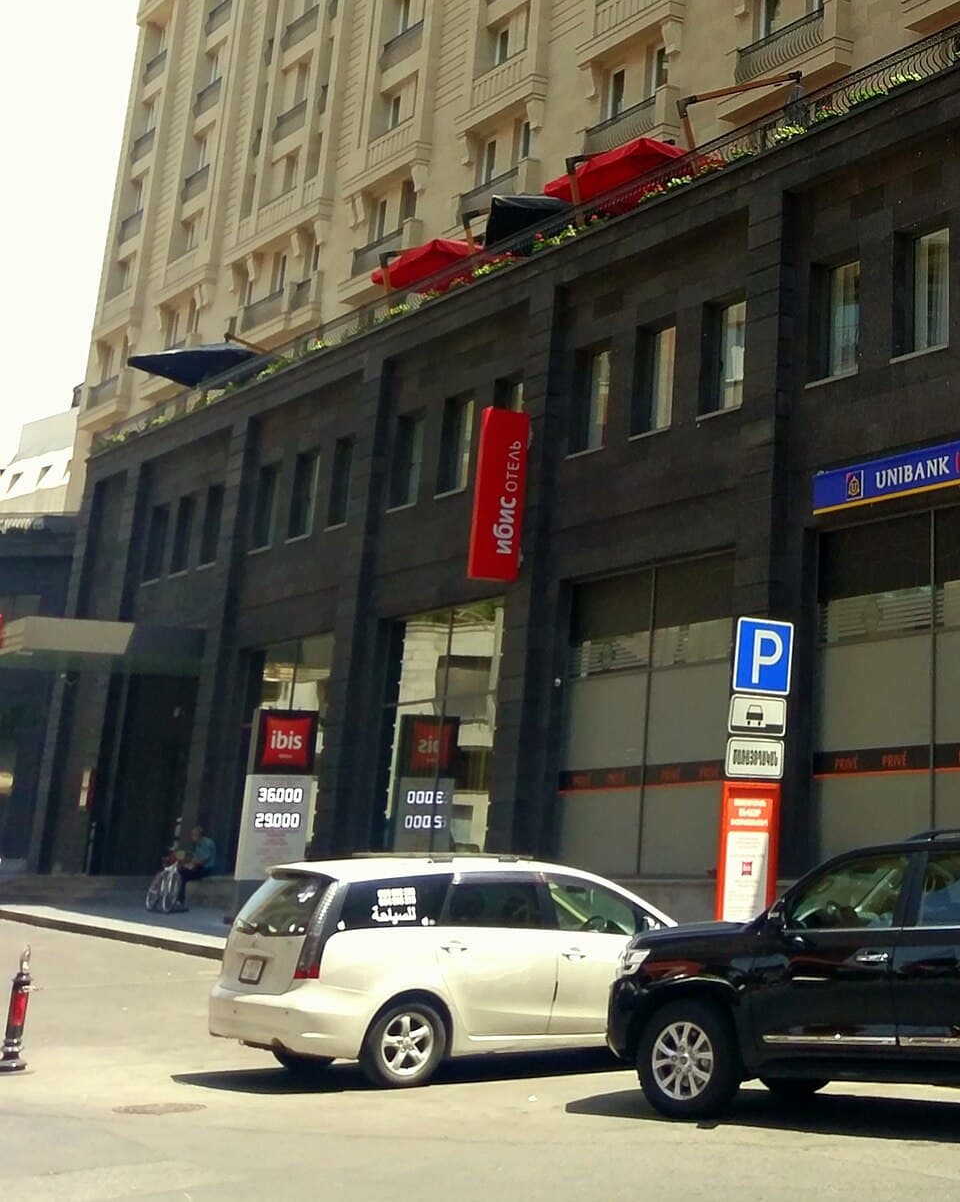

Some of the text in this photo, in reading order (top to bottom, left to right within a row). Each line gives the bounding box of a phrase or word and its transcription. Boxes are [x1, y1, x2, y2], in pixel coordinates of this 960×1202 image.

[505, 440, 522, 493] ОТЕЛЬ
[875, 455, 950, 489] UNIBANK
[751, 629, 783, 684] P
[270, 729, 303, 750] ibis
